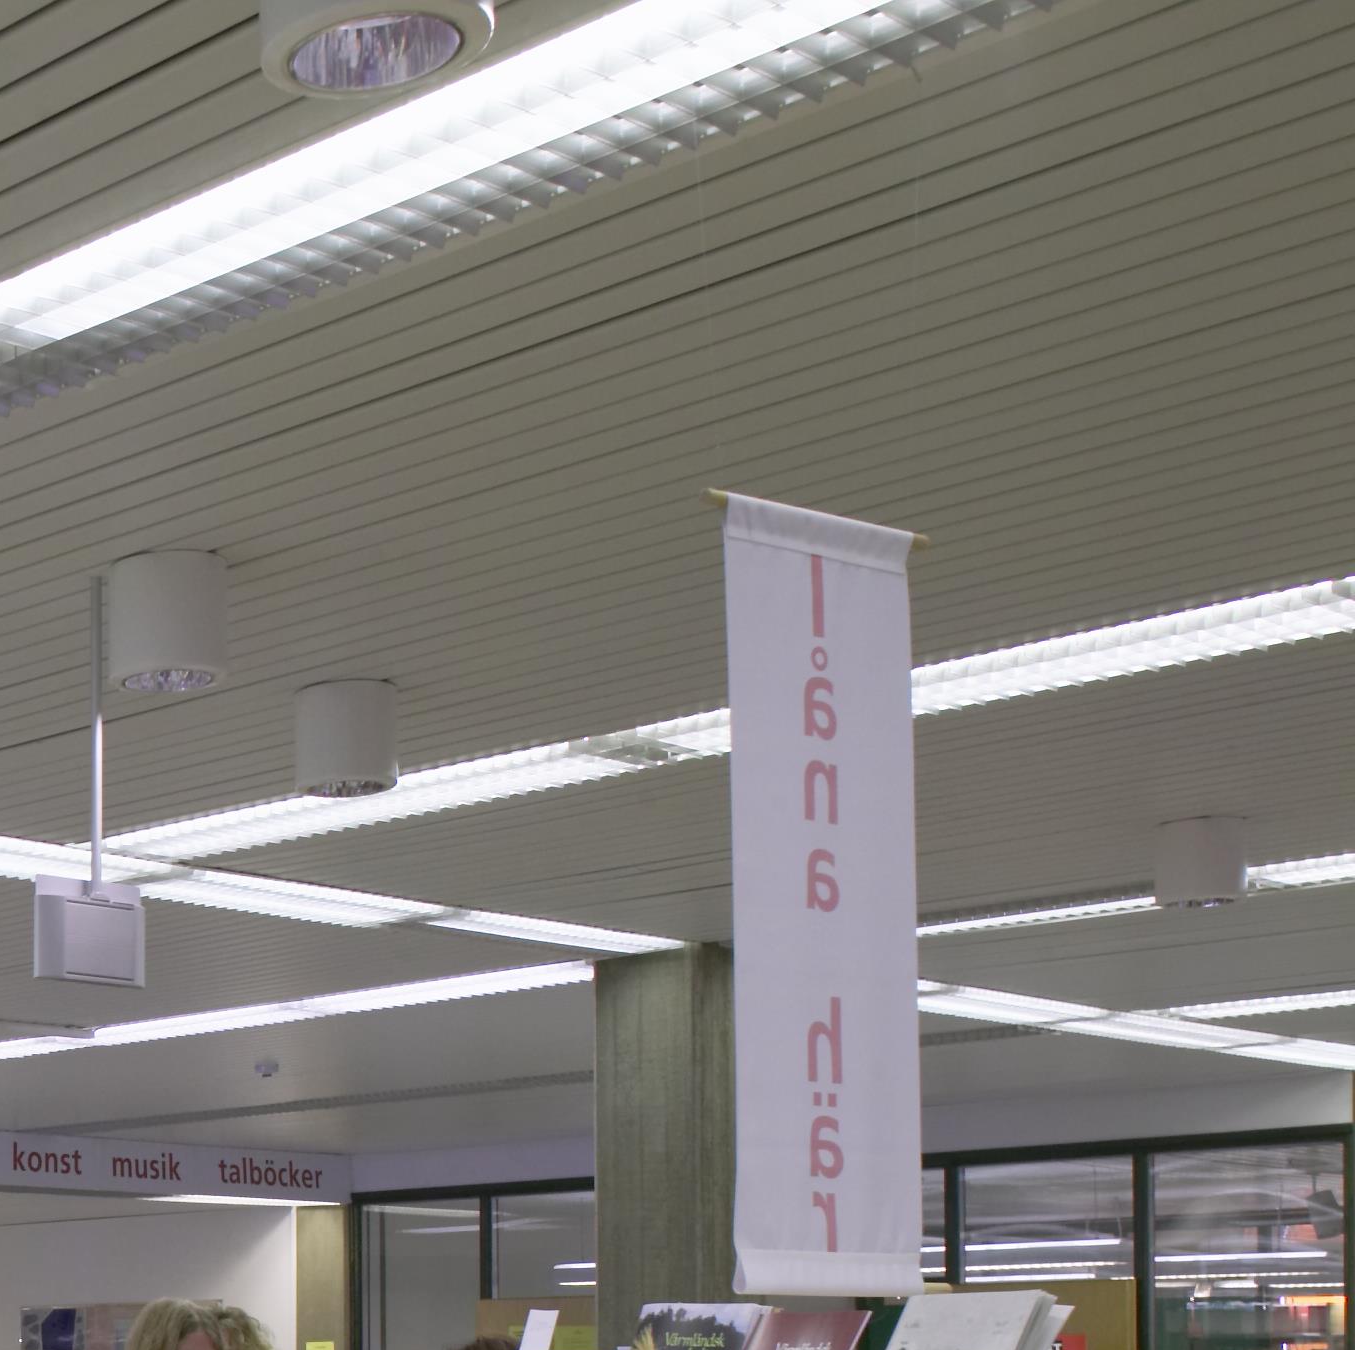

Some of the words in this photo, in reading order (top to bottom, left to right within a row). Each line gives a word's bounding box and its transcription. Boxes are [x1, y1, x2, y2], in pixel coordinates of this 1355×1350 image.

[12, 1141, 83, 1175] konst
[112, 1153, 182, 1182] musik
[218, 1157, 323, 1190] talböcker
[665, 1332, 725, 1348] Värmländsk
